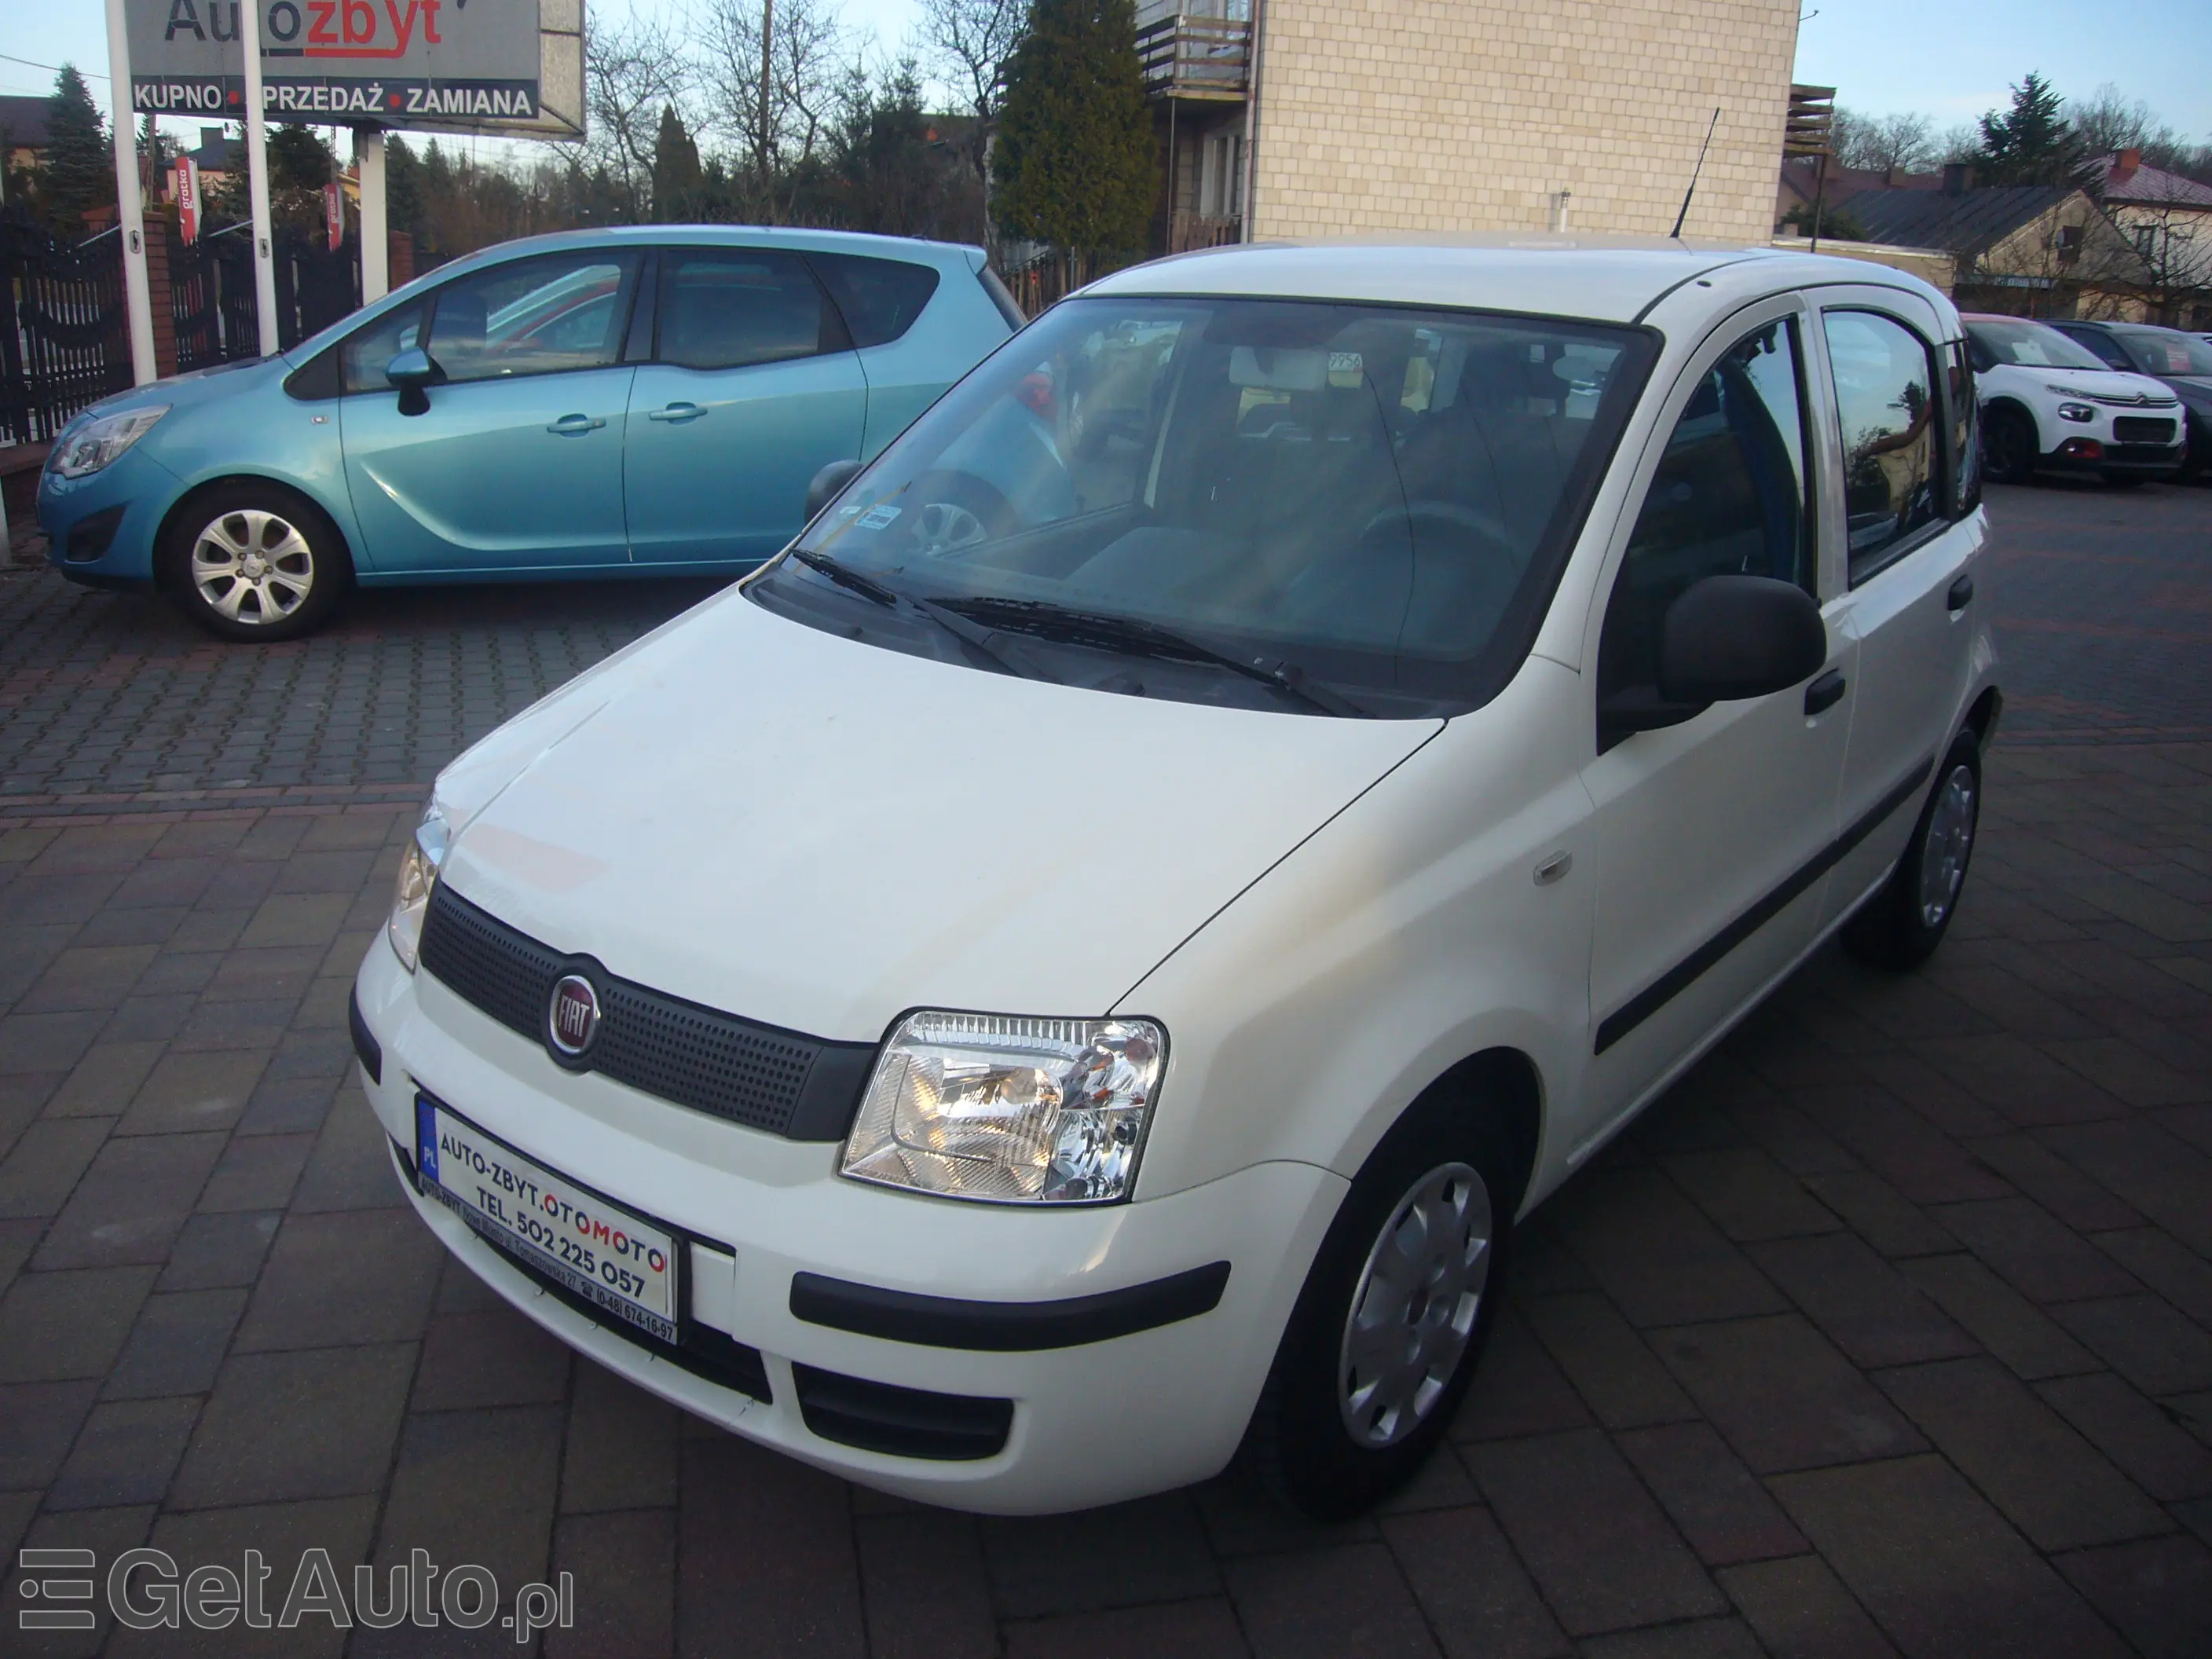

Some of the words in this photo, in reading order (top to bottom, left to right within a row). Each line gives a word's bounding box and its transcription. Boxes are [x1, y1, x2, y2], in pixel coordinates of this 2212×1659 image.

[165, 0, 441, 58] Auozbyt
[134, 84, 222, 109] KUPNO
[259, 82, 384, 112] PRZEDAŻ
[406, 88, 533, 115] ZAMIANA
[179, 170, 194, 209] gratka
[558, 994, 590, 1037] FIAT
[423, 1146, 437, 1169] PL
[477, 1185, 513, 1226] TEL.
[517, 1210, 555, 1251] 502
[559, 1236, 595, 1273] 225
[601, 1261, 646, 1298] 057
[624, 1304, 673, 1341] 674-16-97
